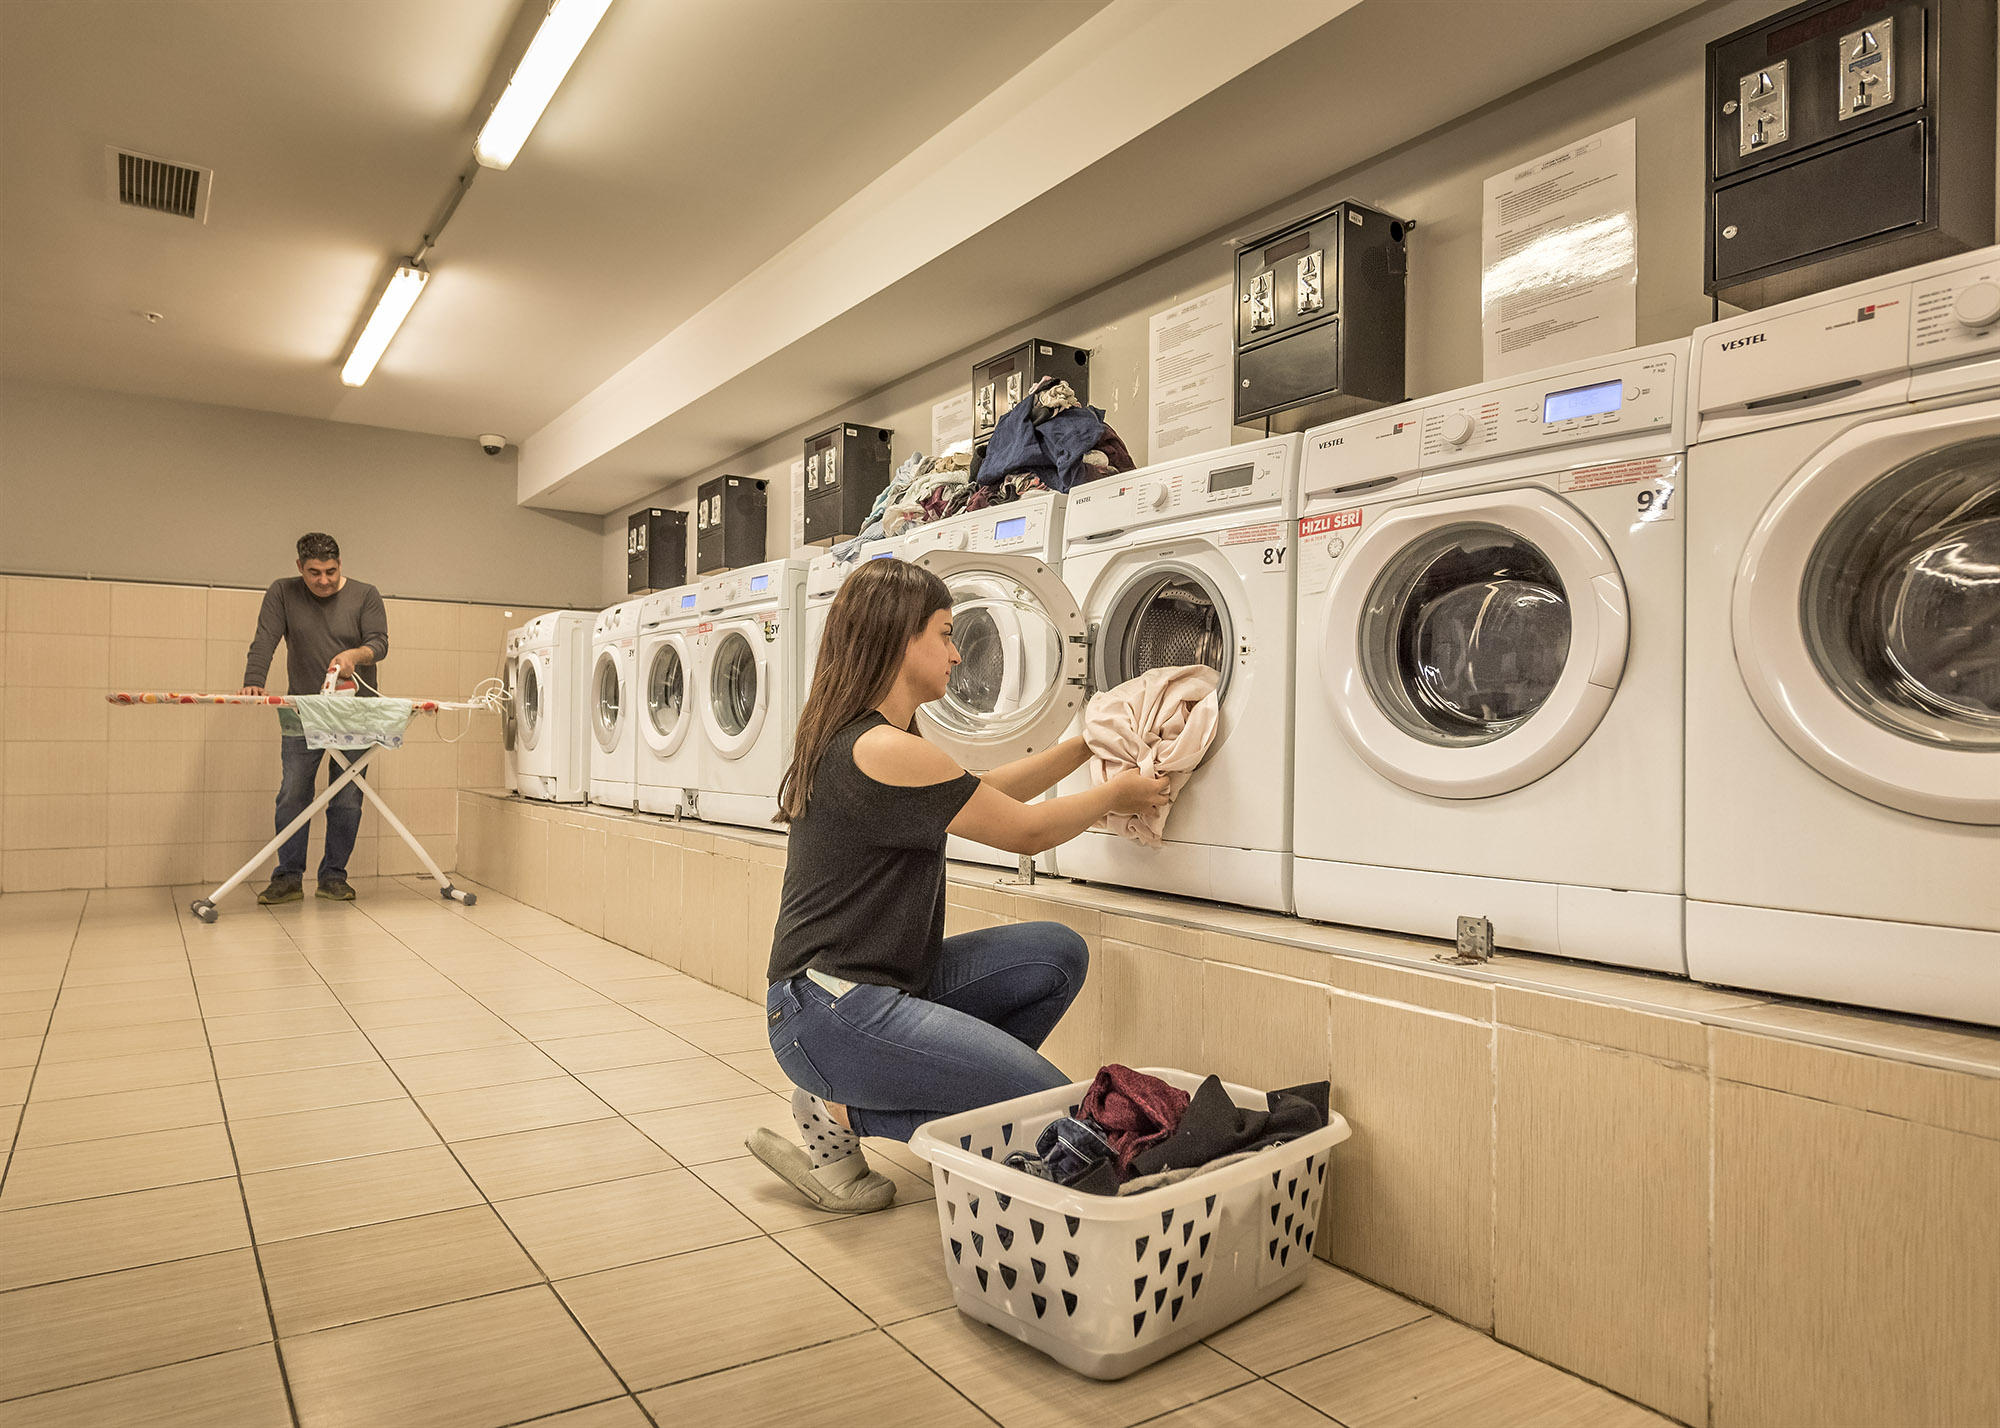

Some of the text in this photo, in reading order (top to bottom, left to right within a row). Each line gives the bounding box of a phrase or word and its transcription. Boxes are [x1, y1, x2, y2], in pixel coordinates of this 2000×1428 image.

[1721, 332, 1768, 352] VESTEL
[1318, 437, 1345, 450] VESTEL
[1302, 517, 1331, 535] HIZLI
[1333, 510, 1360, 529] SERİ
[1263, 546, 1287, 566] 8Y
